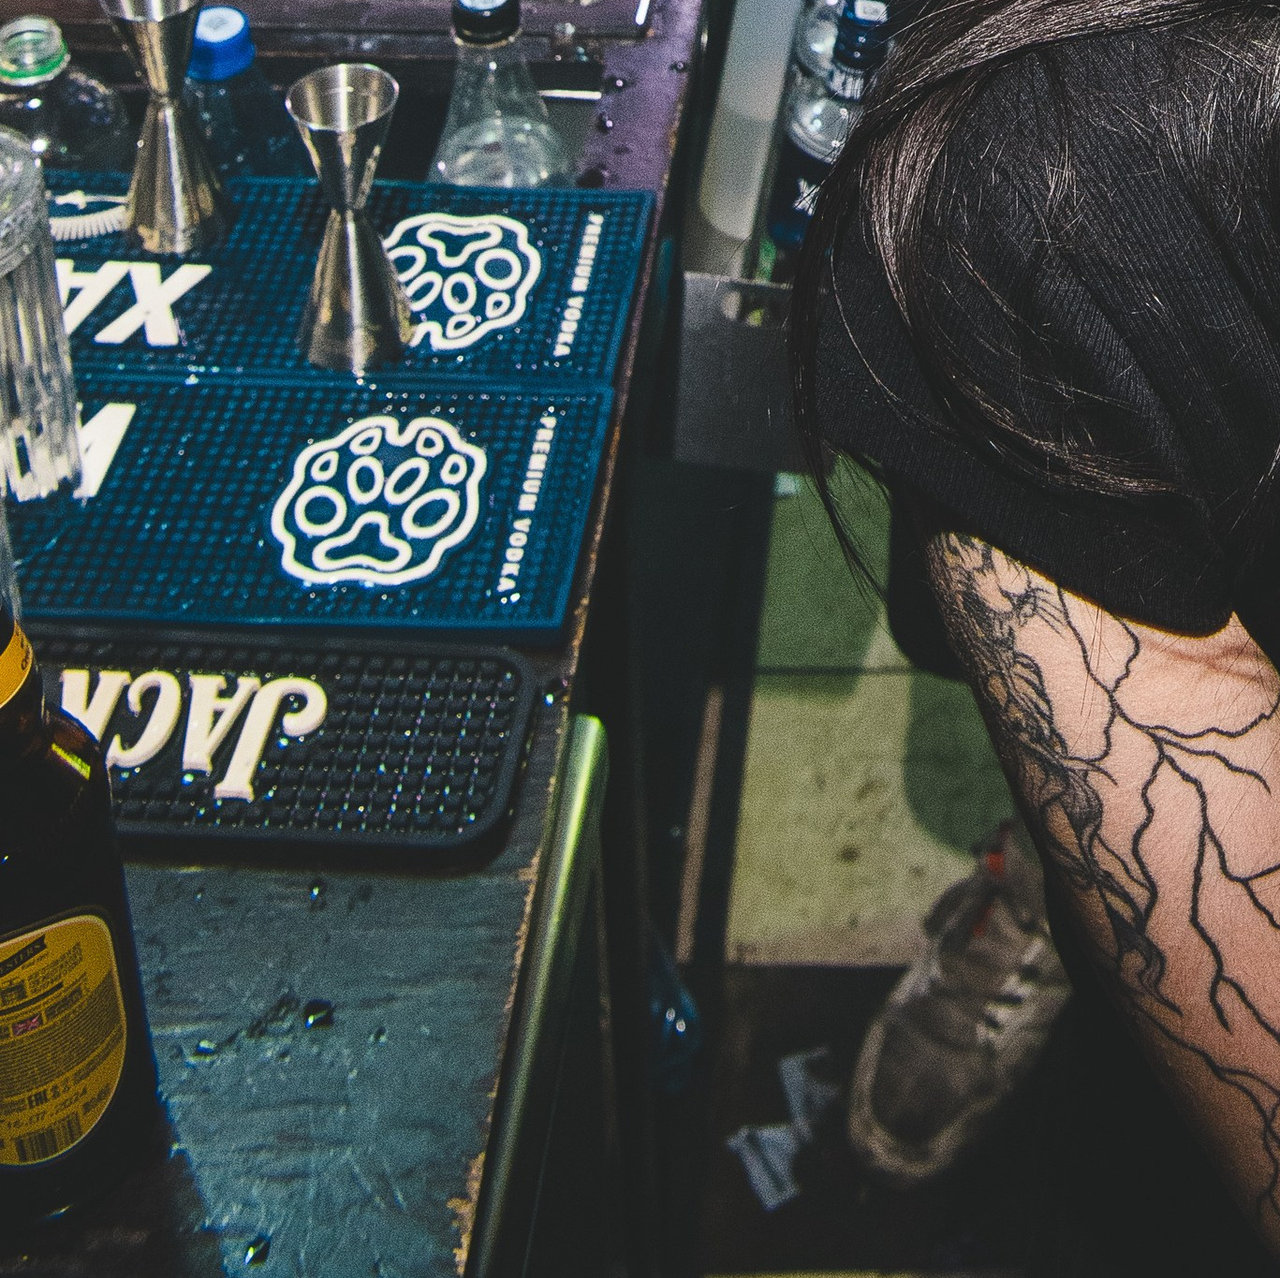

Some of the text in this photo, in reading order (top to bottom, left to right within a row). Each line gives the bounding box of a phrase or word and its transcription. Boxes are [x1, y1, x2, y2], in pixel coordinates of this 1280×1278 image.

[554, 212, 605, 357] PREMIUM VODKA
[497, 415, 558, 592] PREMIUM VODKA
